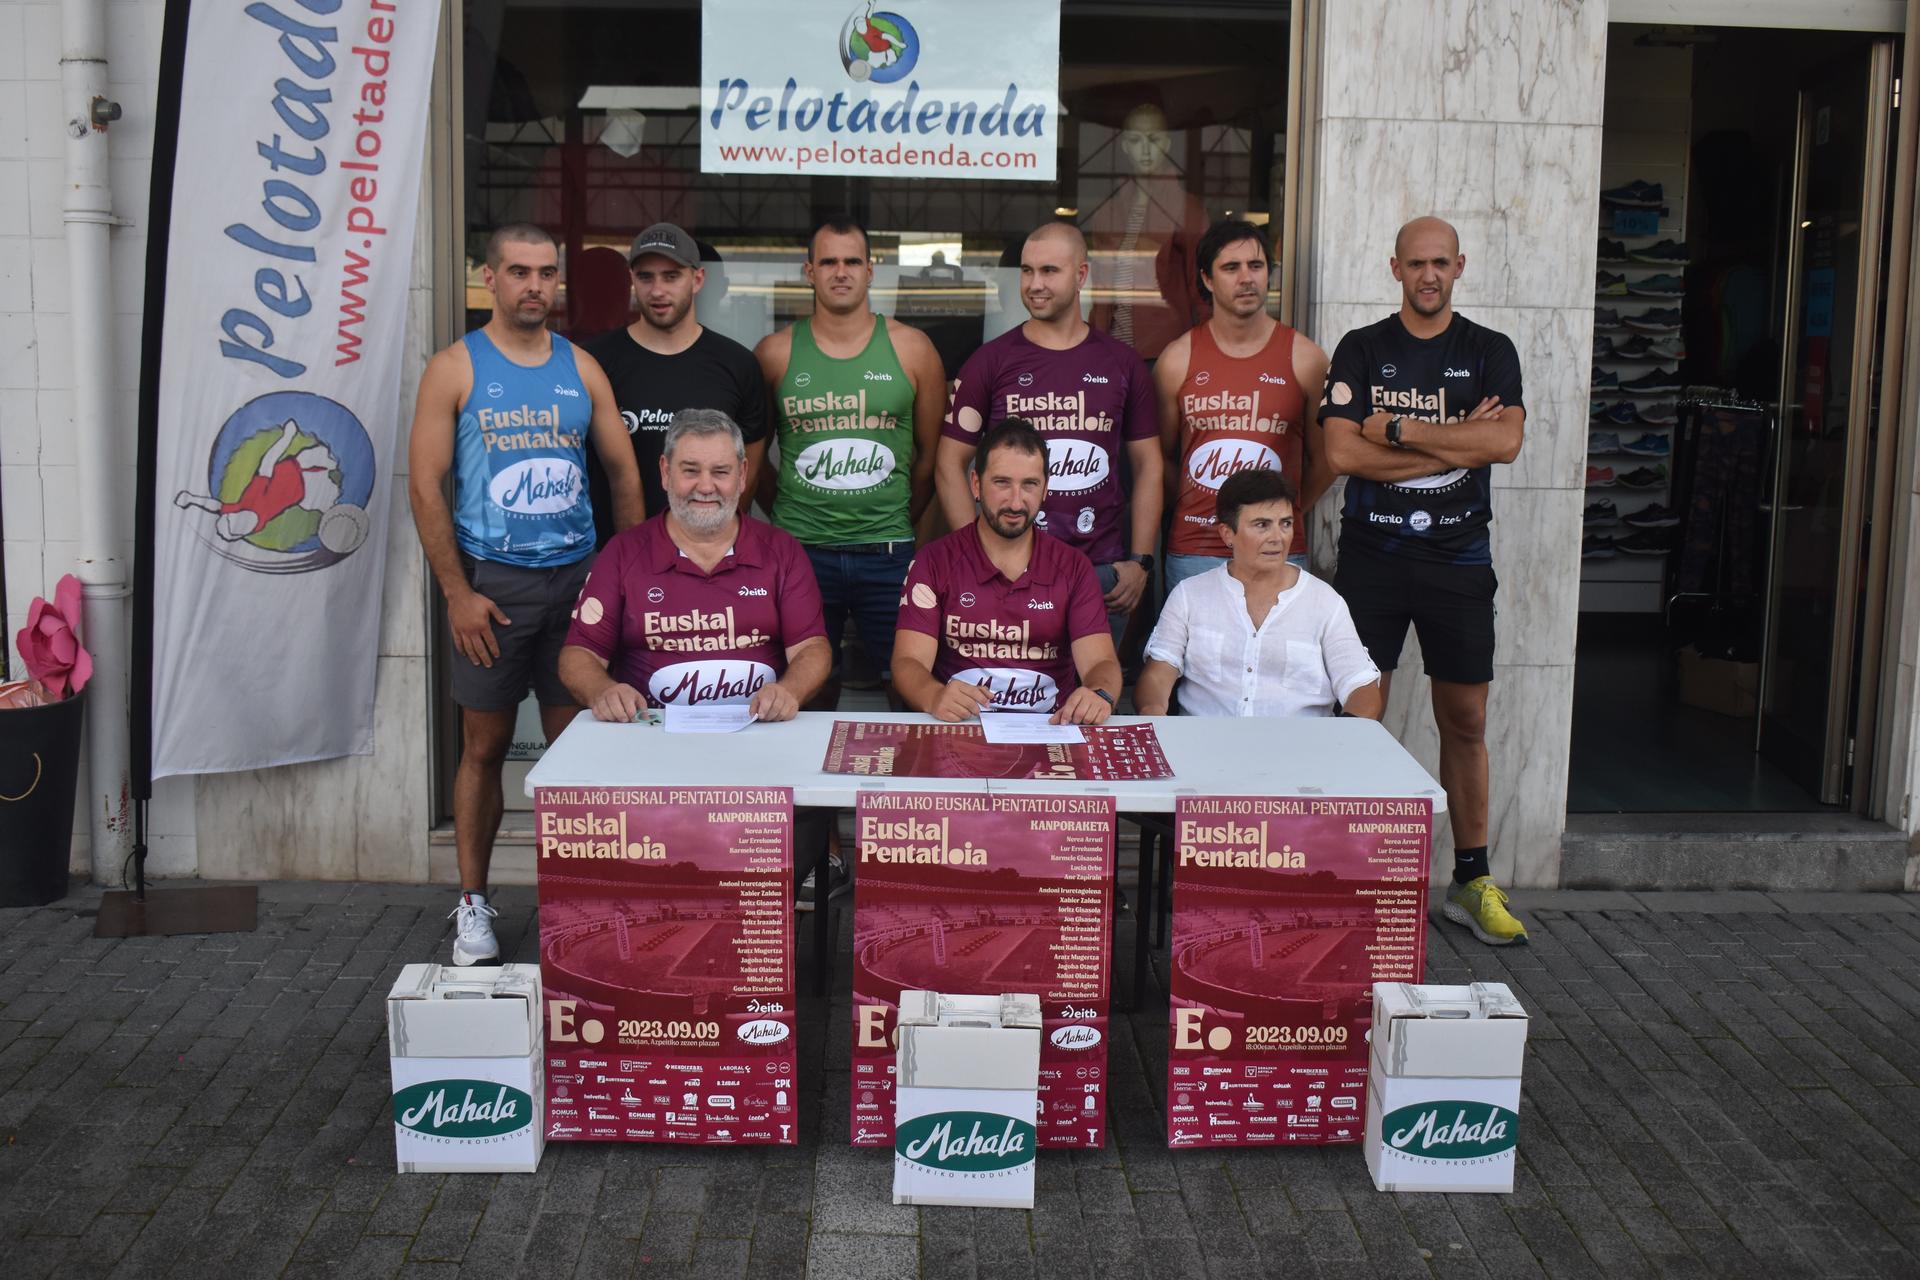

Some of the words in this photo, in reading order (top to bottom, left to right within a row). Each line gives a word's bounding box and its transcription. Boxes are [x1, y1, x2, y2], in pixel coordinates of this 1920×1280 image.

[710, 77, 1047, 137] Pelotadenda
[720, 141, 1037, 169] www.pelotadenda.com
[219, 0, 342, 378] Pelotad
[874, 372, 892, 381] eitb
[1092, 375, 1108, 384] eitb
[1269, 376, 1286, 385] eitb
[1454, 368, 1470, 377] eitb
[784, 389, 866, 416] Euskal
[1006, 391, 1084, 413] Euskal
[1183, 390, 1260, 415] Euskal
[1370, 385, 1445, 411] Euskal
[478, 404, 559, 431] Euskal
[640, 408, 675, 423] Pelot
[788, 410, 897, 433] Pentatloia
[1006, 411, 1114, 432] ntatloia
[1186, 413, 1288, 435] Pentatloia
[805, 444, 884, 481] Mahala
[1048, 446, 1101, 477] ahala
[1194, 447, 1272, 480] Mahala
[503, 464, 577, 507] Mahala
[1369, 512, 1403, 525] trento
[750, 587, 767, 596] eitb
[1037, 601, 1054, 610] eitb
[644, 606, 736, 634] Euskal
[946, 615, 1030, 642] Euskal
[659, 664, 764, 706] Mahala
[612, 791, 666, 805] EUSKAL
[669, 791, 743, 805] PENTATLOI
[746, 790, 787, 804] SARIA
[935, 797, 989, 812] EUSKAL
[992, 798, 1065, 813] PENTATLOI
[1068, 800, 1109, 814] SARIA
[1181, 800, 1252, 815] I.MAILAKO
[1254, 801, 1308, 815] EUSKAL
[1311, 801, 1383, 816] PENTATLOI
[1386, 802, 1427, 816] SARIA
[541, 811, 627, 836] Euskal
[708, 812, 788, 823] KANPORAKETA
[862, 816, 949, 841] Euskal
[1030, 820, 1110, 832] KANPORAKETA
[1348, 823, 1427, 834] KANPORAKETA
[1180, 820, 1268, 845] Euskal
[542, 835, 666, 860] Pentatloia
[861, 841, 988, 866] Pentatloia
[1180, 845, 1306, 868] Pentatloia
[760, 1002, 783, 1013] eitb
[1074, 1009, 1097, 1019] eitb
[617, 1019, 720, 1039] 2023.09.09
[743, 1023, 782, 1039] Mahala
[1056, 1029, 1094, 1044] Mahala
[1245, 1026, 1348, 1043] 2023.09.09
[774, 1079, 791, 1088] CPK
[1084, 1084, 1100, 1093] CPK
[402, 1087, 517, 1128] Mahala
[400, 1128, 450, 1145] SERRIKO
[459, 1127, 530, 1145] PRODUKTUA
[1391, 1107, 1508, 1149] Mahala
[905, 1119, 1025, 1161] Mahala
[1381, 1146, 1437, 1166] ASERRIKO
[1446, 1149, 1515, 1167] PRODUKTU
[896, 1157, 954, 1178] ASERRIKO
[964, 1162, 1035, 1179] PRODUKTU
